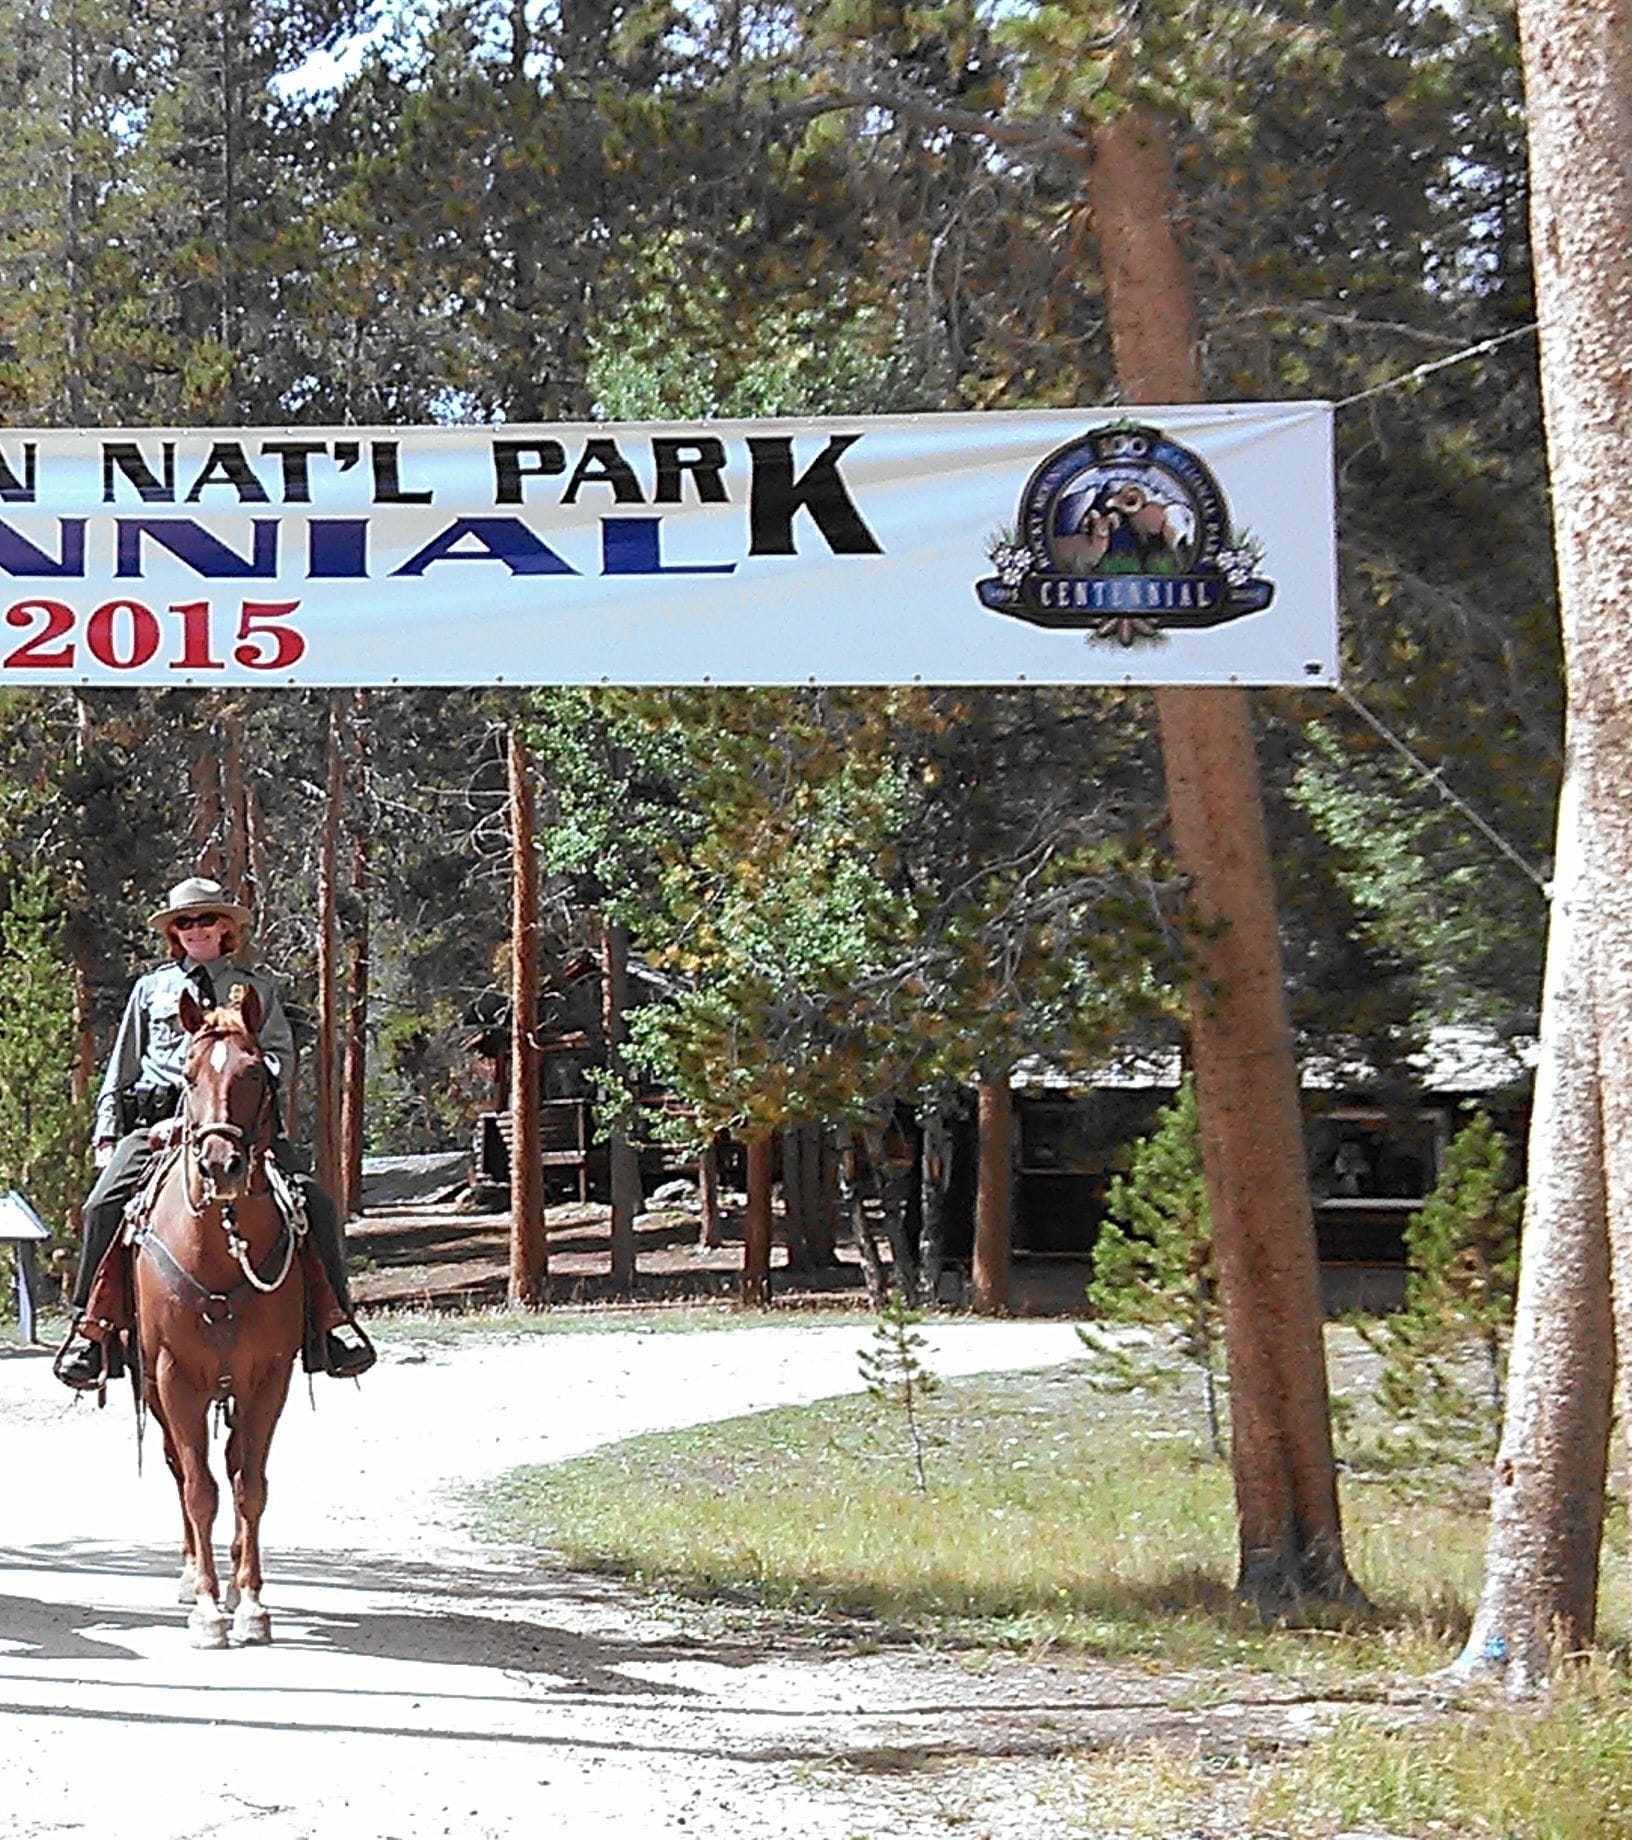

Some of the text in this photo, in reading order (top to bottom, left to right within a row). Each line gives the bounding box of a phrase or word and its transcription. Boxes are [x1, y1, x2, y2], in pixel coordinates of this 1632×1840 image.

[101, 440, 434, 504] NAT'L
[491, 432, 886, 556] PARK
[1039, 580, 1213, 608] CENTENNIAL
[3, 599, 306, 670] 2015
